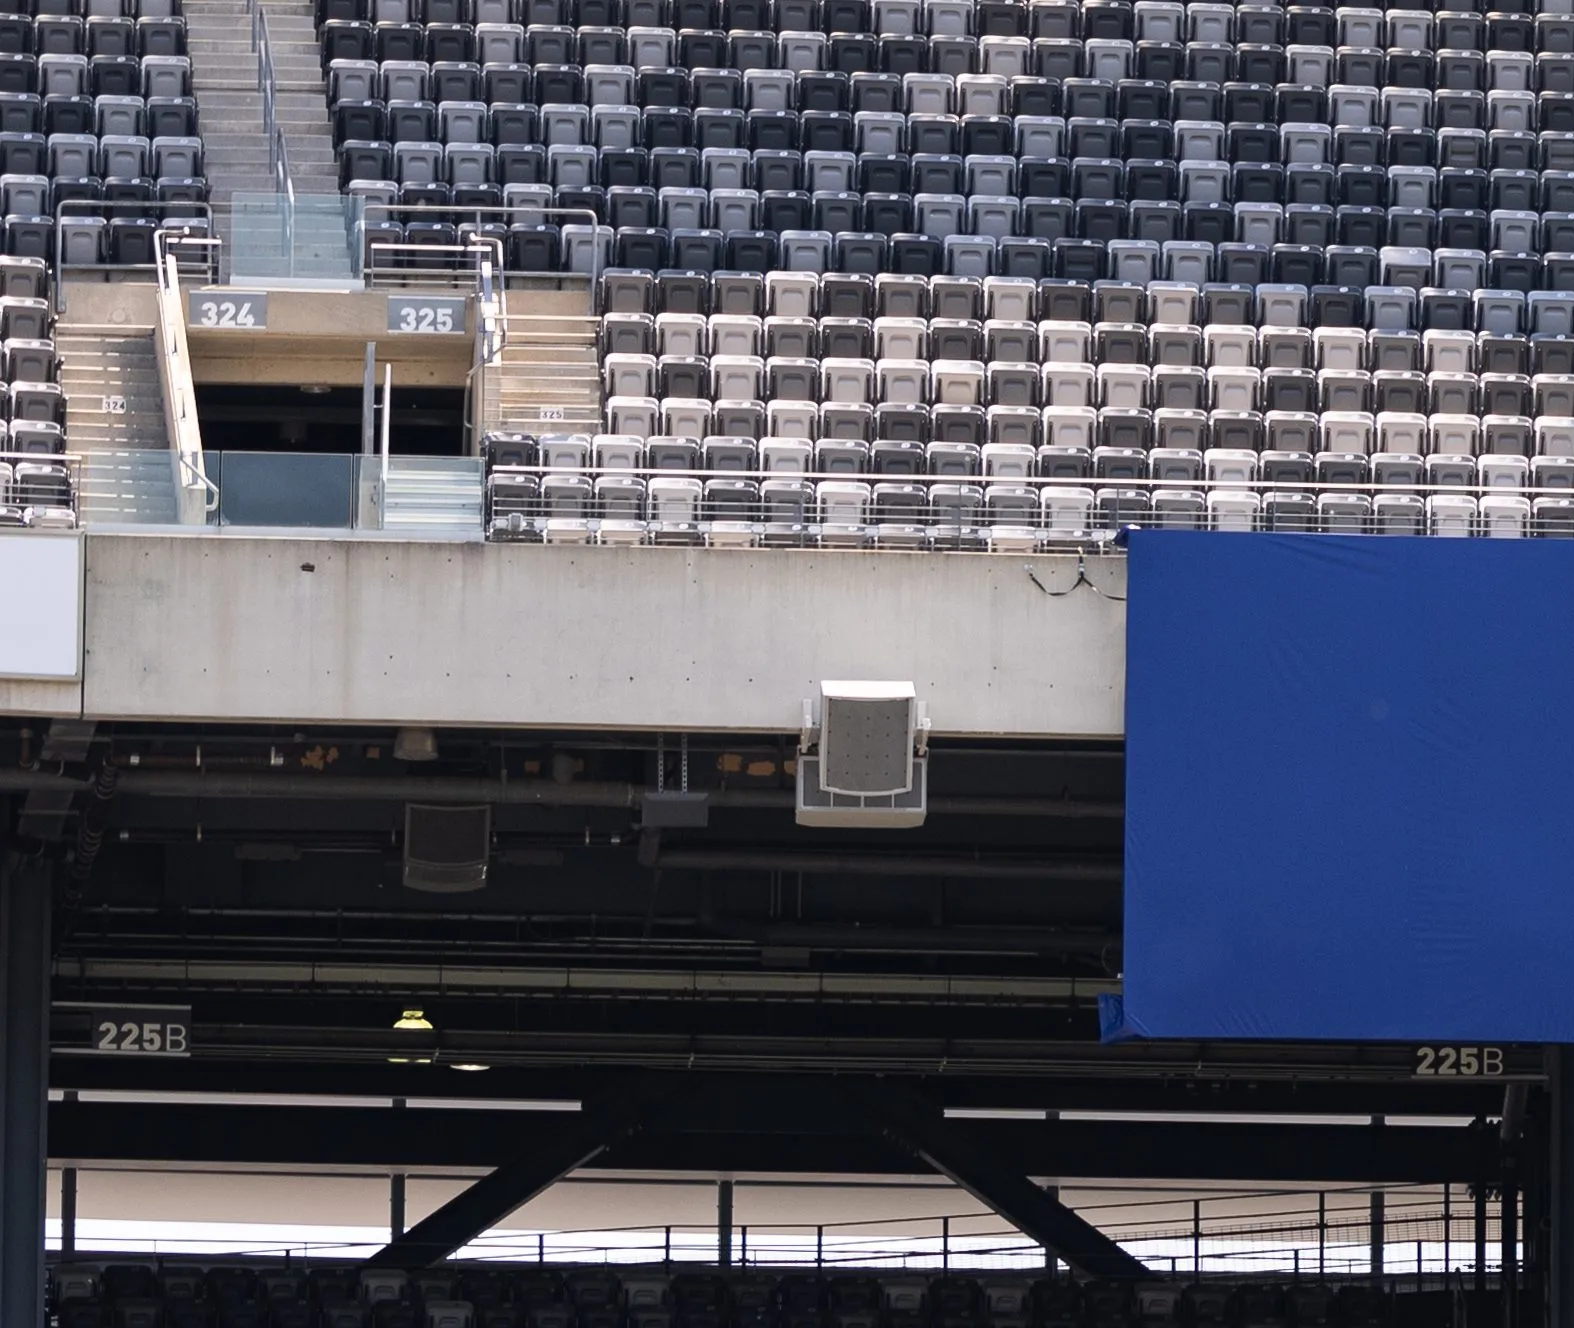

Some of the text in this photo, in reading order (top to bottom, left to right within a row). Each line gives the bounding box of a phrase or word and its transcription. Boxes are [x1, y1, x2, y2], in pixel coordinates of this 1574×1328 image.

[200, 302, 255, 328] 324
[400, 307, 453, 333] 325
[104, 401, 125, 411] 324
[98, 1022, 188, 1053] 225B
[1416, 1046, 1503, 1076] 225B
